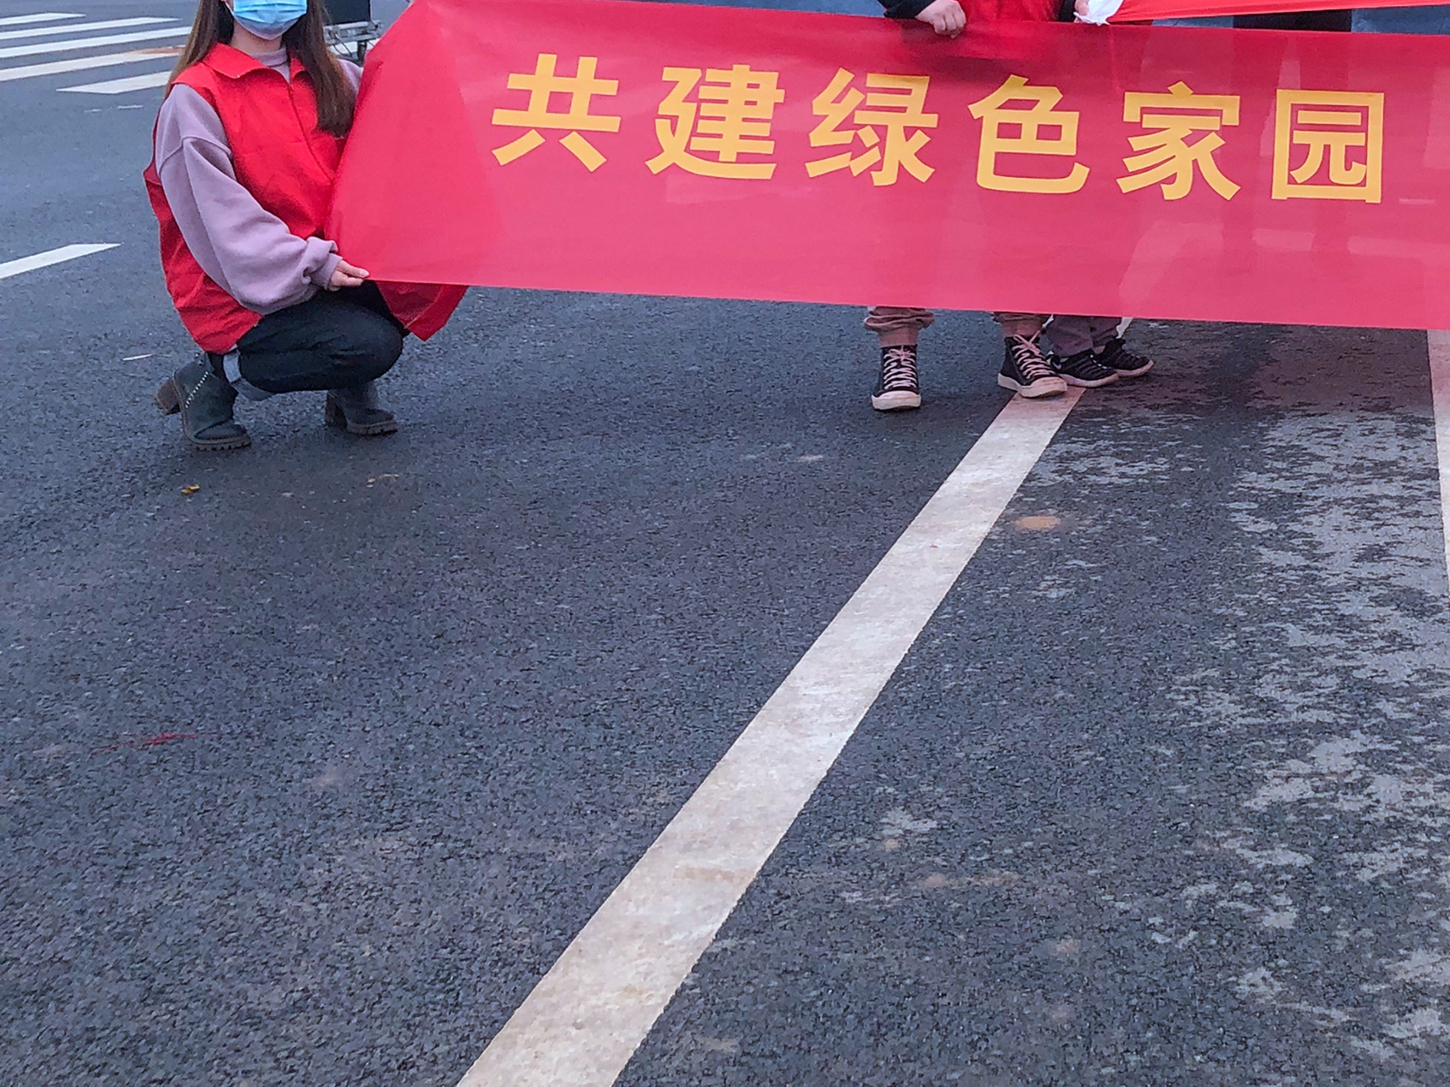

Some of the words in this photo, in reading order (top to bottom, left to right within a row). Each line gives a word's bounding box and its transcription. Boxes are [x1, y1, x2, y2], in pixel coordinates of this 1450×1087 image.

[492, 54, 1386, 203] 共建绿色家园
